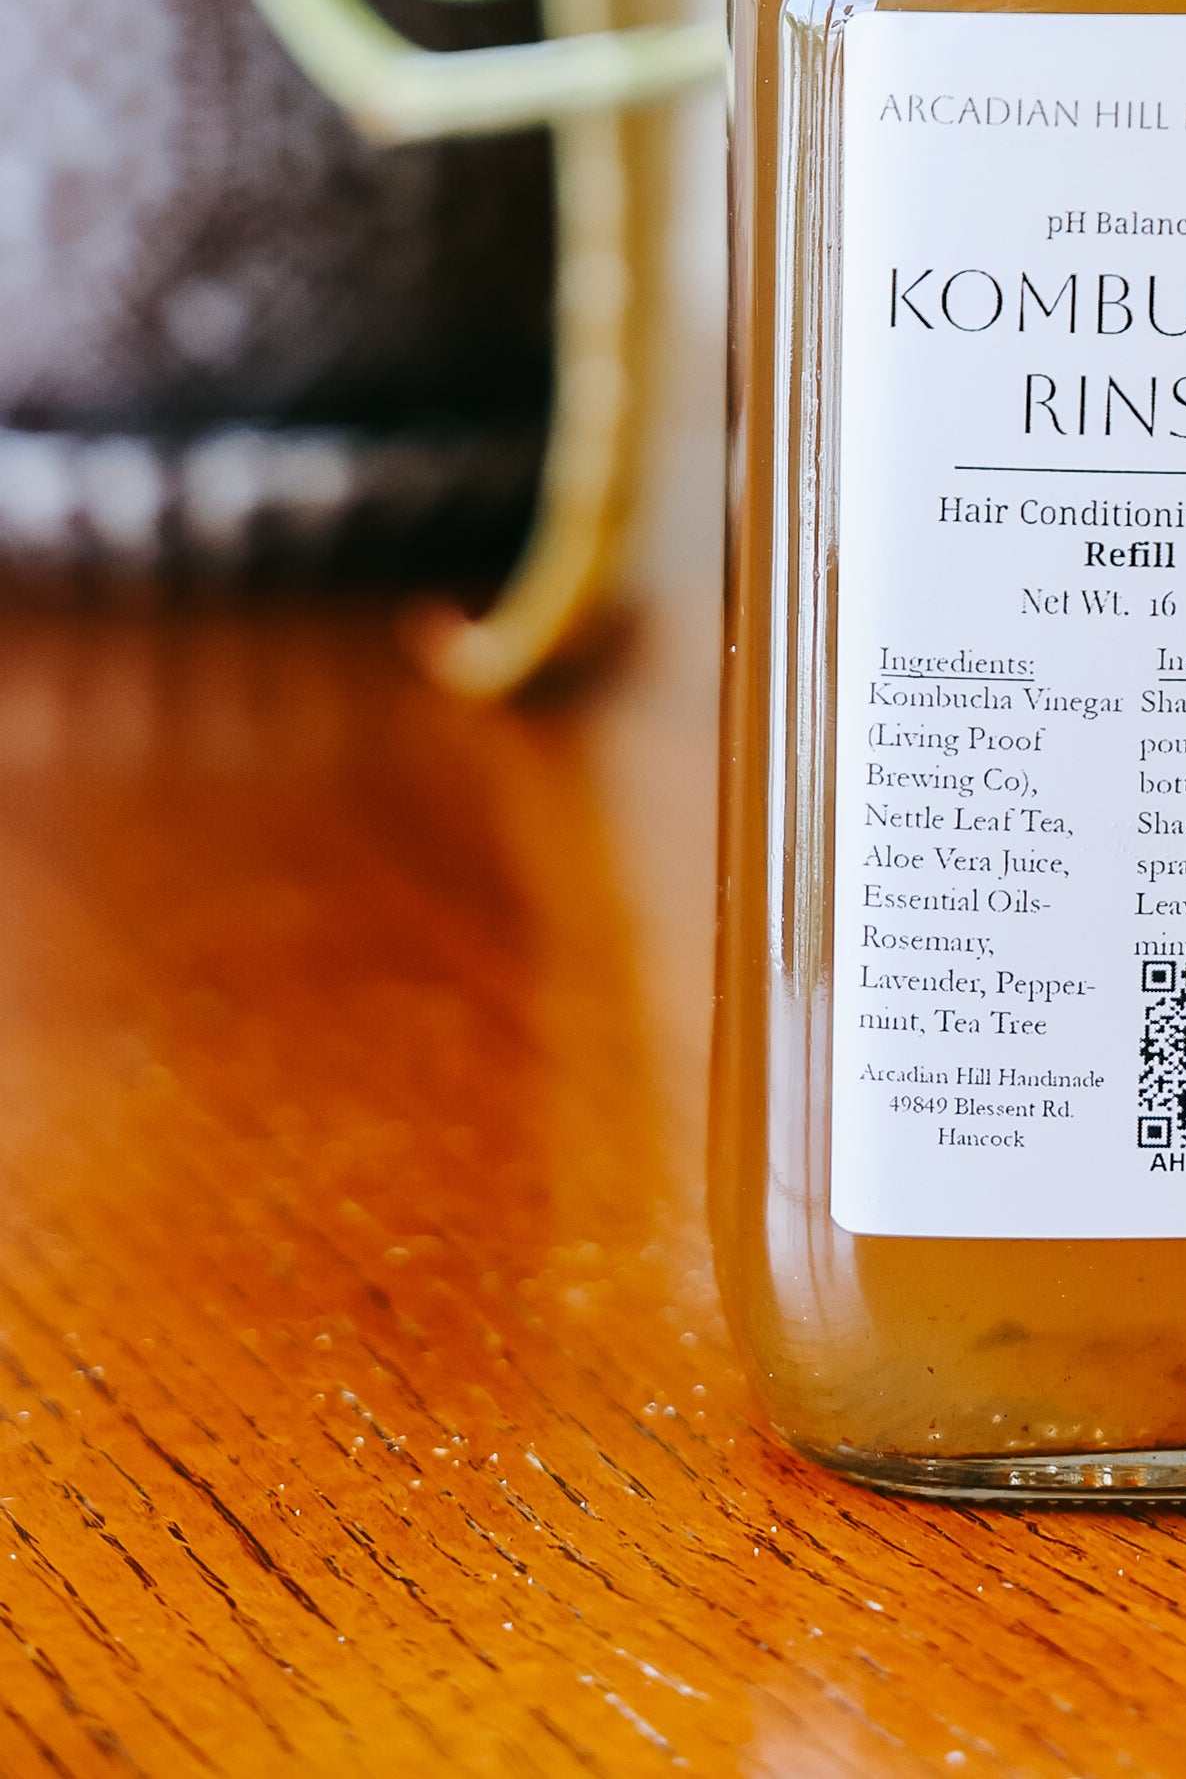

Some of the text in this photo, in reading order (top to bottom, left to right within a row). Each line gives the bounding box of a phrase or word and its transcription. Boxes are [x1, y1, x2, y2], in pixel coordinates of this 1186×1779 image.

[879, 93, 1079, 128] ARCADIAN
[1095, 100, 1169, 130] HILL
[1045, 210, 1087, 241] pH
[937, 495, 1010, 525] Hair
[1083, 539, 1177, 569] Refill
[1020, 587, 1071, 616] Net
[1080, 589, 1130, 617] Wt.
[1148, 590, 1177, 618] 16
[878, 646, 1035, 679] Ingredients:
[868, 681, 1125, 721] Kombucha Vinegar
[868, 722, 1047, 758] (Living Proof
[865, 762, 1038, 799] Brewing Co),
[864, 802, 1074, 840] Nettle Leaf Tea,
[862, 844, 1070, 881] Aloe Vera Juice,
[861, 883, 1052, 914] Essential Oils-
[860, 924, 995, 961] Rosemary,
[858, 964, 1097, 1002] Lavender, Pepper-
[858, 1007, 1048, 1038] mint, Tea Tree
[859, 1062, 1106, 1089] Arcadian Hill Handmade
[888, 1094, 1075, 1119] 49849 Blessent Rd.
[937, 1126, 1026, 1149] Hancock
